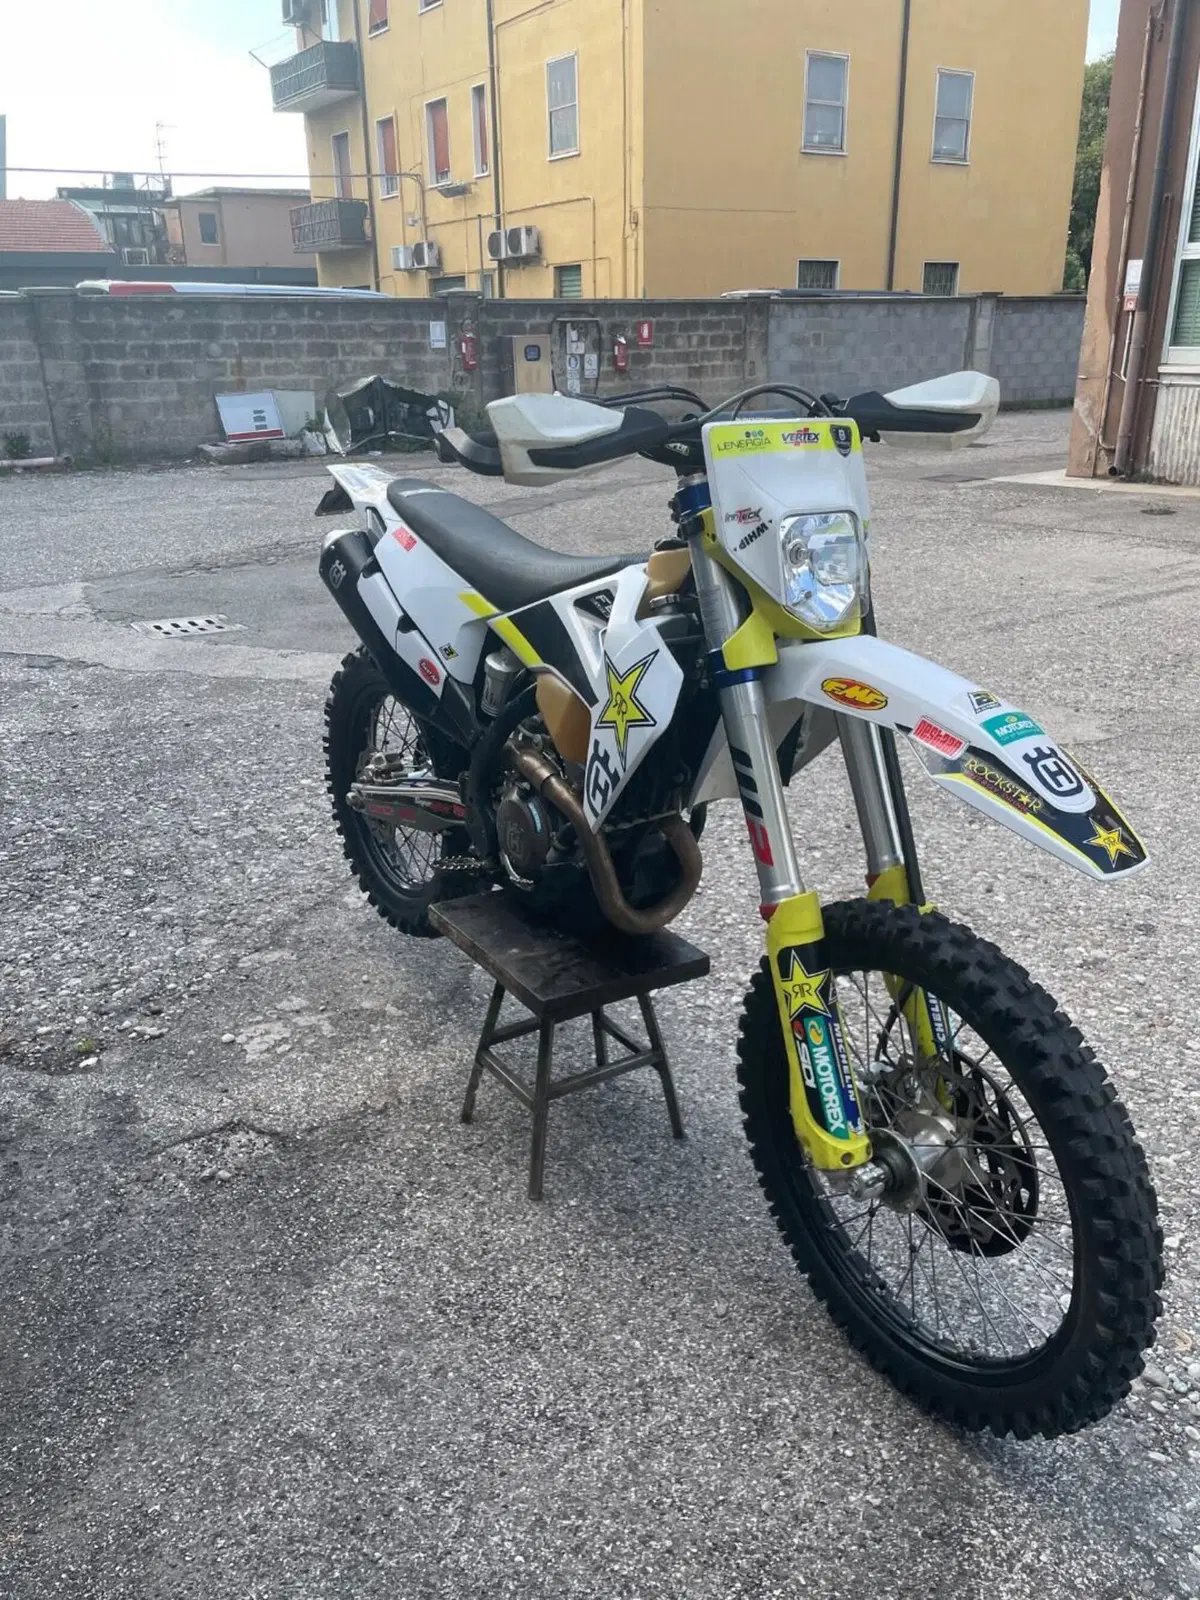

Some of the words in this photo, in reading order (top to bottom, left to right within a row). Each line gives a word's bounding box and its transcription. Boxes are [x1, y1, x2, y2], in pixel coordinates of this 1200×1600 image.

[716, 437, 772, 452] LENERGIA
[781, 431, 820, 443] VERTEX
[738, 522, 769, 550] WHIP
[822, 679, 888, 704] FMF
[994, 720, 1035, 737] MOTOREX
[833, 1022, 856, 1102] MICHELIN
[812, 1046, 846, 1133] MOTOREX
